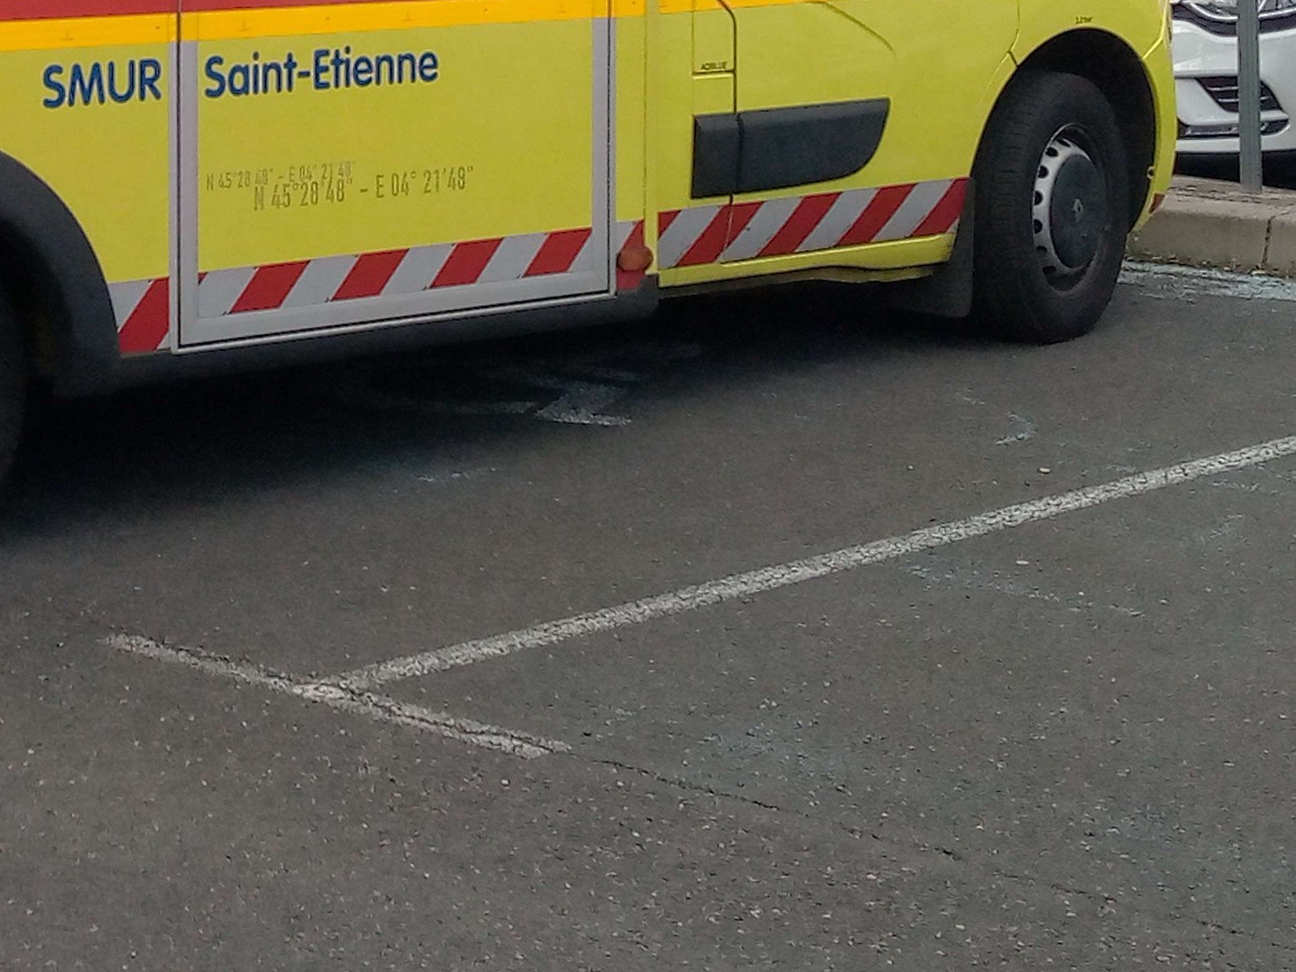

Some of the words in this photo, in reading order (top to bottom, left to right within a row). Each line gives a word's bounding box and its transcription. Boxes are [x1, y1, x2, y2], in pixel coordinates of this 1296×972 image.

[42, 56, 162, 109] SMUR
[204, 46, 439, 99] Saint-Etienne
[254, 185, 265, 211] N
[376, 174, 385, 198] E
